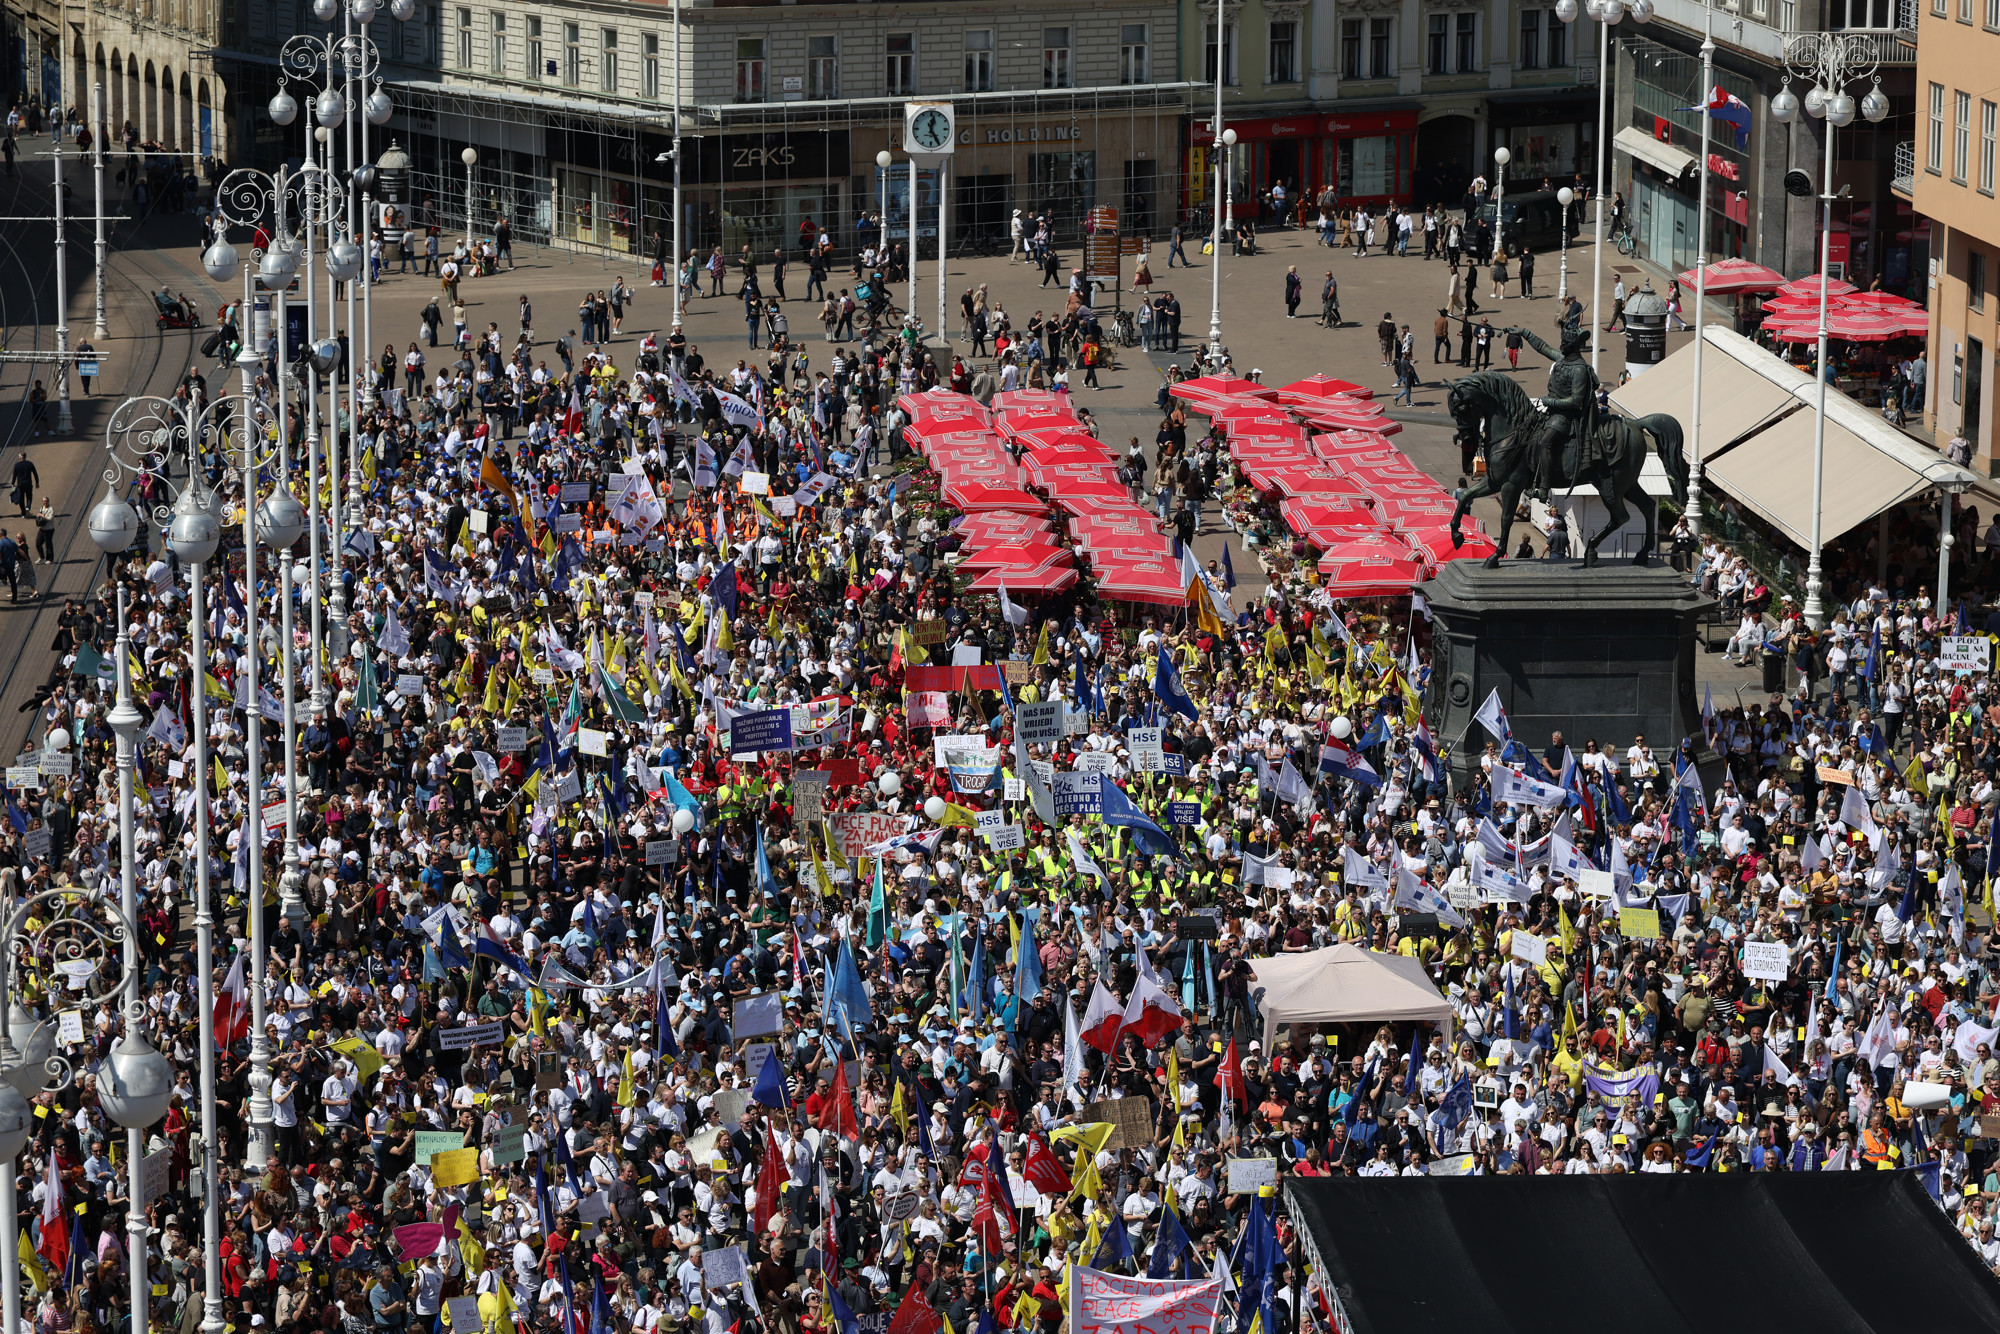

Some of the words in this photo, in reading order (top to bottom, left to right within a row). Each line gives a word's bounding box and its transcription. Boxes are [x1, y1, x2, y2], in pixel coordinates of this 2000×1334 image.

[986, 126, 1081, 144] HOLDING
[733, 146, 795, 167] ZAKS
[1192, 150, 1201, 186] ATM
[918, 694, 933, 707] Mi
[1022, 707, 1039, 718] NAŠ
[1039, 706, 1055, 716] RAD
[754, 714, 783, 724] POVEĆANJE
[1024, 717, 1052, 728] VRIJEDI
[755, 723, 774, 732] SKLADU
[1039, 728, 1060, 738] VIŠE!
[765, 736, 783, 745] ŽIVOTA
[1139, 762, 1159, 770] VŠE
[1082, 775, 1100, 785] HS
[1055, 793, 1091, 805] ZAJEDNO
[1055, 803, 1075, 815] VEĆE
[1078, 802, 1101, 812] PLAĆ
[833, 812, 865, 830] VEĆE
[870, 815, 904, 835] PLAĆE
[844, 830, 861, 841] ZA
[996, 832, 1017, 840] VRIJEDI
[648, 848, 677, 856] ZASLUŽUJU
[1632, 918, 1646, 927] NIJE
[1748, 945, 1761, 957] STOP
[1762, 946, 1782, 960] POREZU
[1745, 959, 1753, 970] NA
[441, 1031, 463, 1039] MOGUĆNOST
[1585, 1065, 1655, 1081] SINDIKAT
[416, 1135, 447, 1144] NOMINALNO
[450, 1134, 462, 1143] VIŠE
[1080, 1298, 1142, 1319] PLAĆE
[859, 1312, 887, 1333] BOLJE
